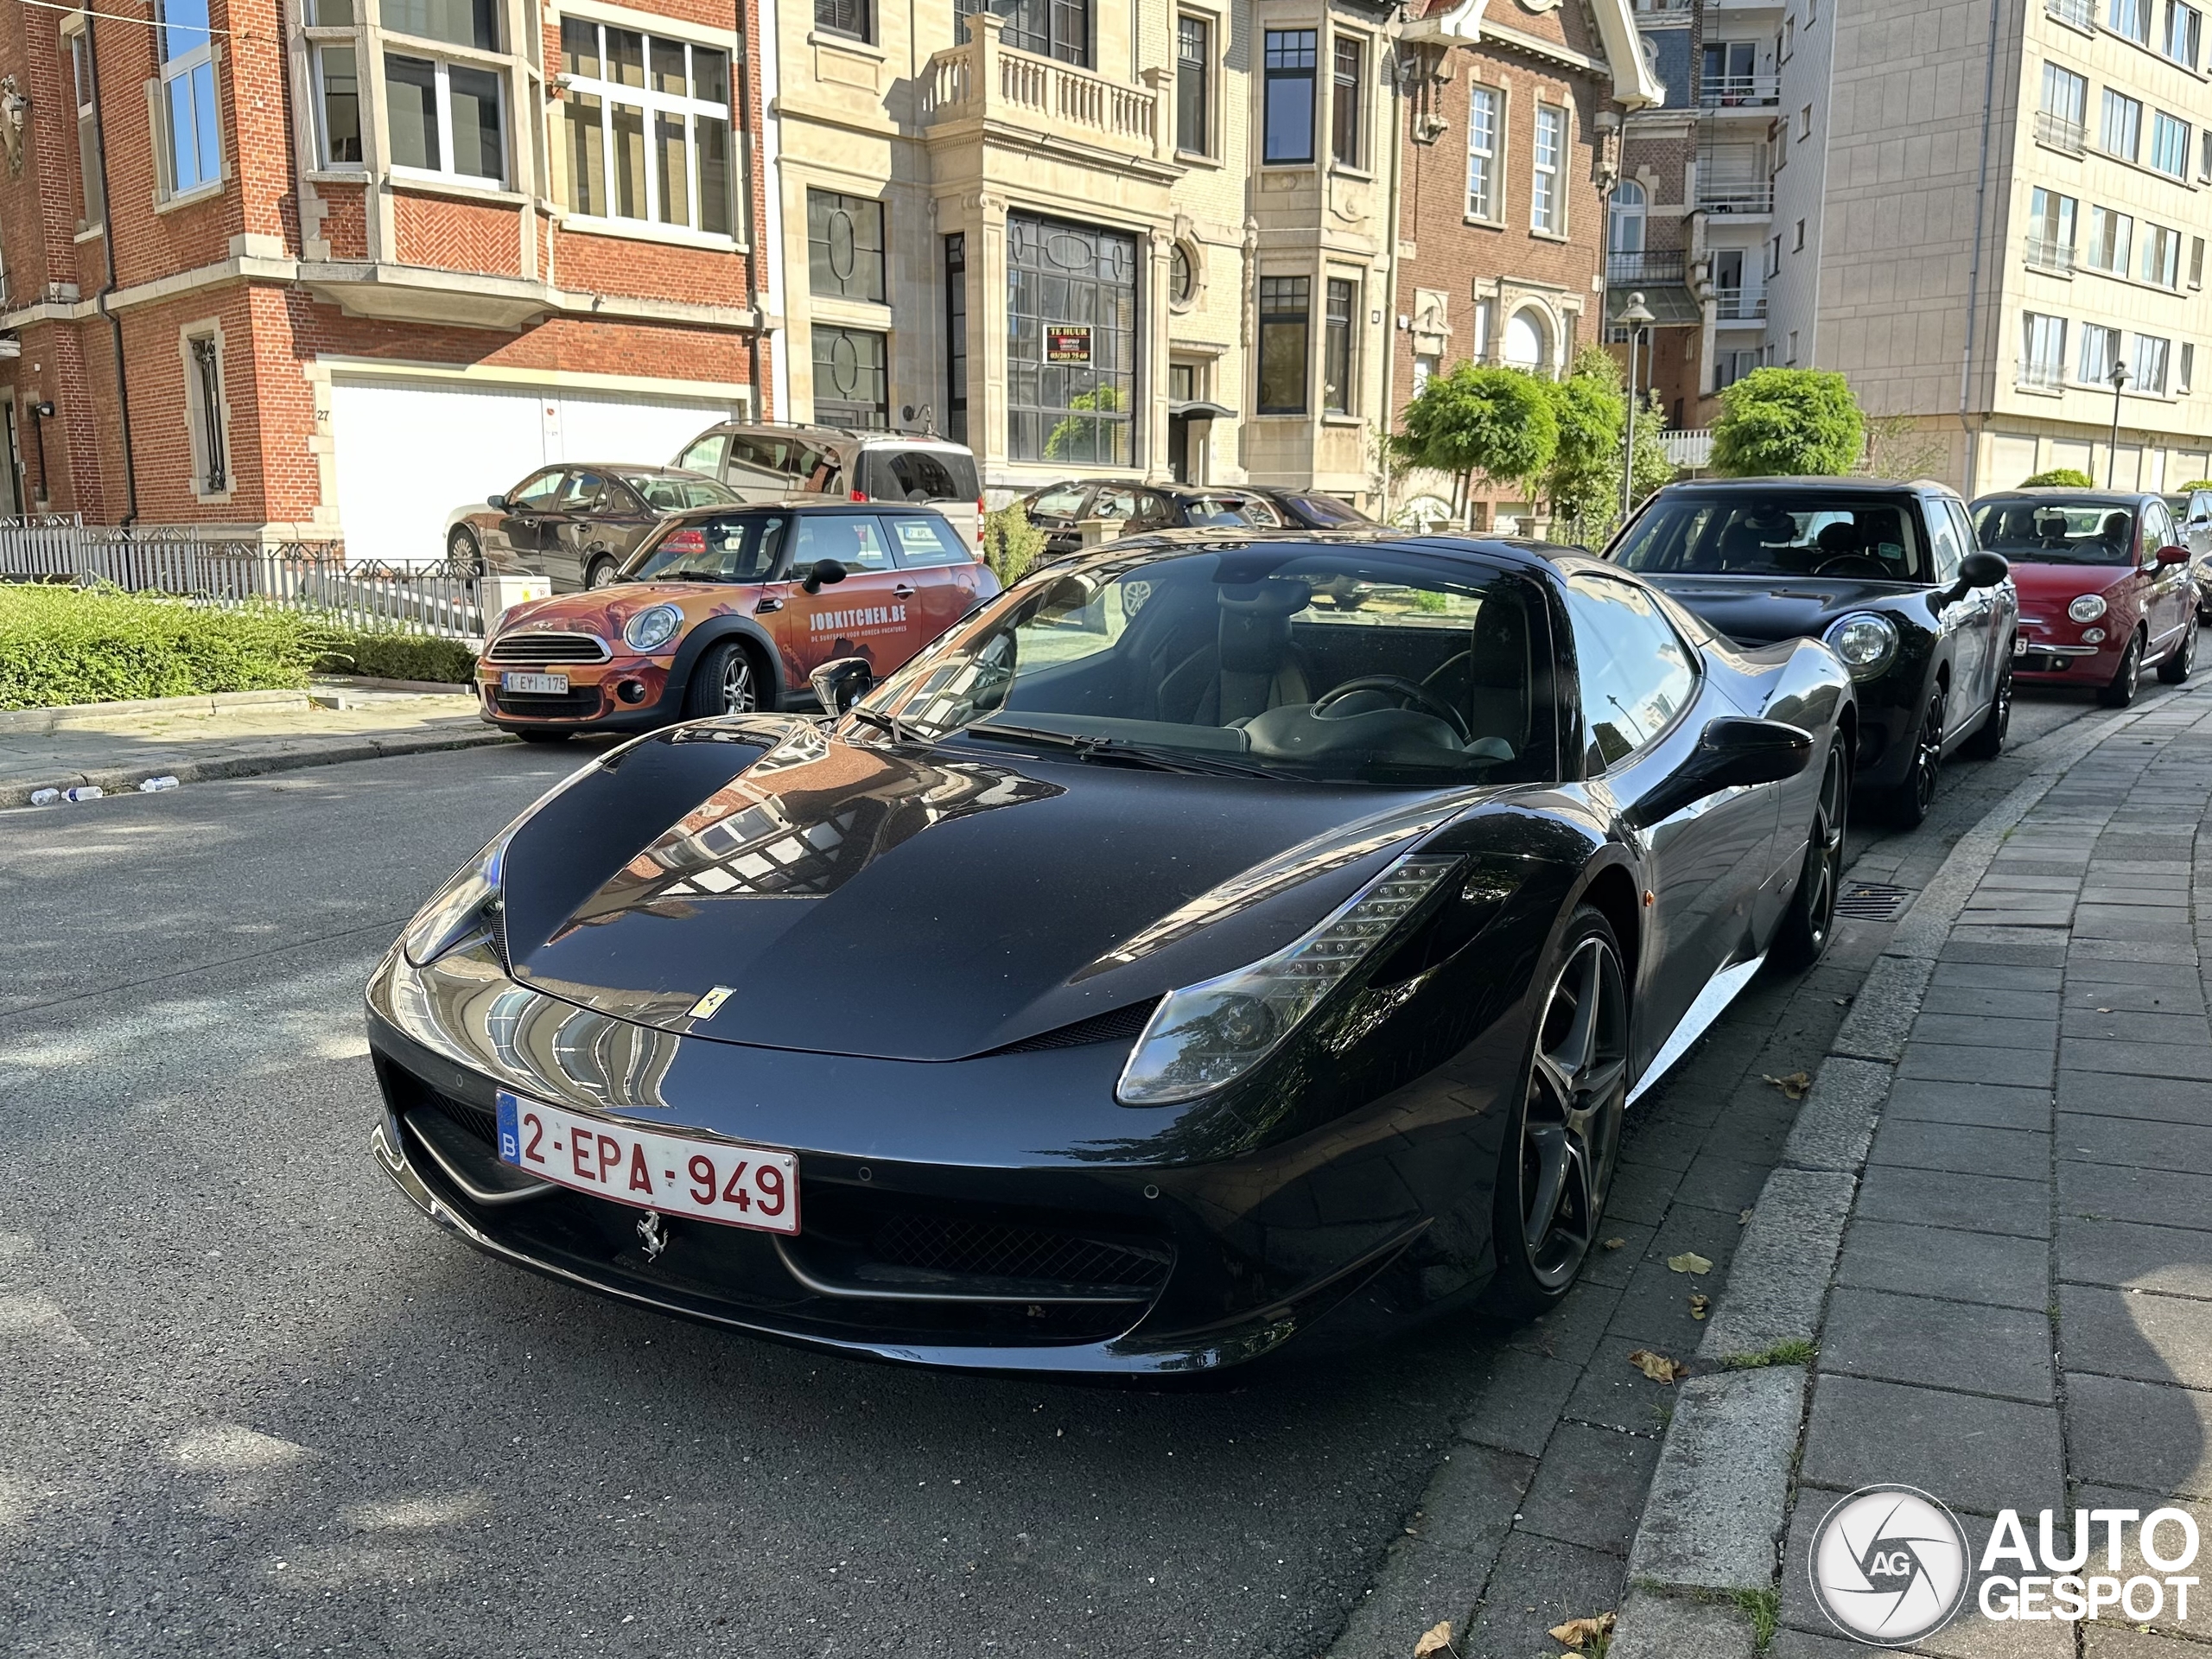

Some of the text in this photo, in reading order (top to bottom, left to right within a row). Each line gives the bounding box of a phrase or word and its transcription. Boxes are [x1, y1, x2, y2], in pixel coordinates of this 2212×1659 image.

[1050, 327, 1087, 336] TE HUUR
[317, 410, 329, 421] 27
[810, 605, 906, 632] JOBKITCHEN.BE
[820, 632, 846, 642] SURFSPOT
[502, 1132, 517, 1158] B
[524, 1113, 785, 1217] 2-EPA-949
